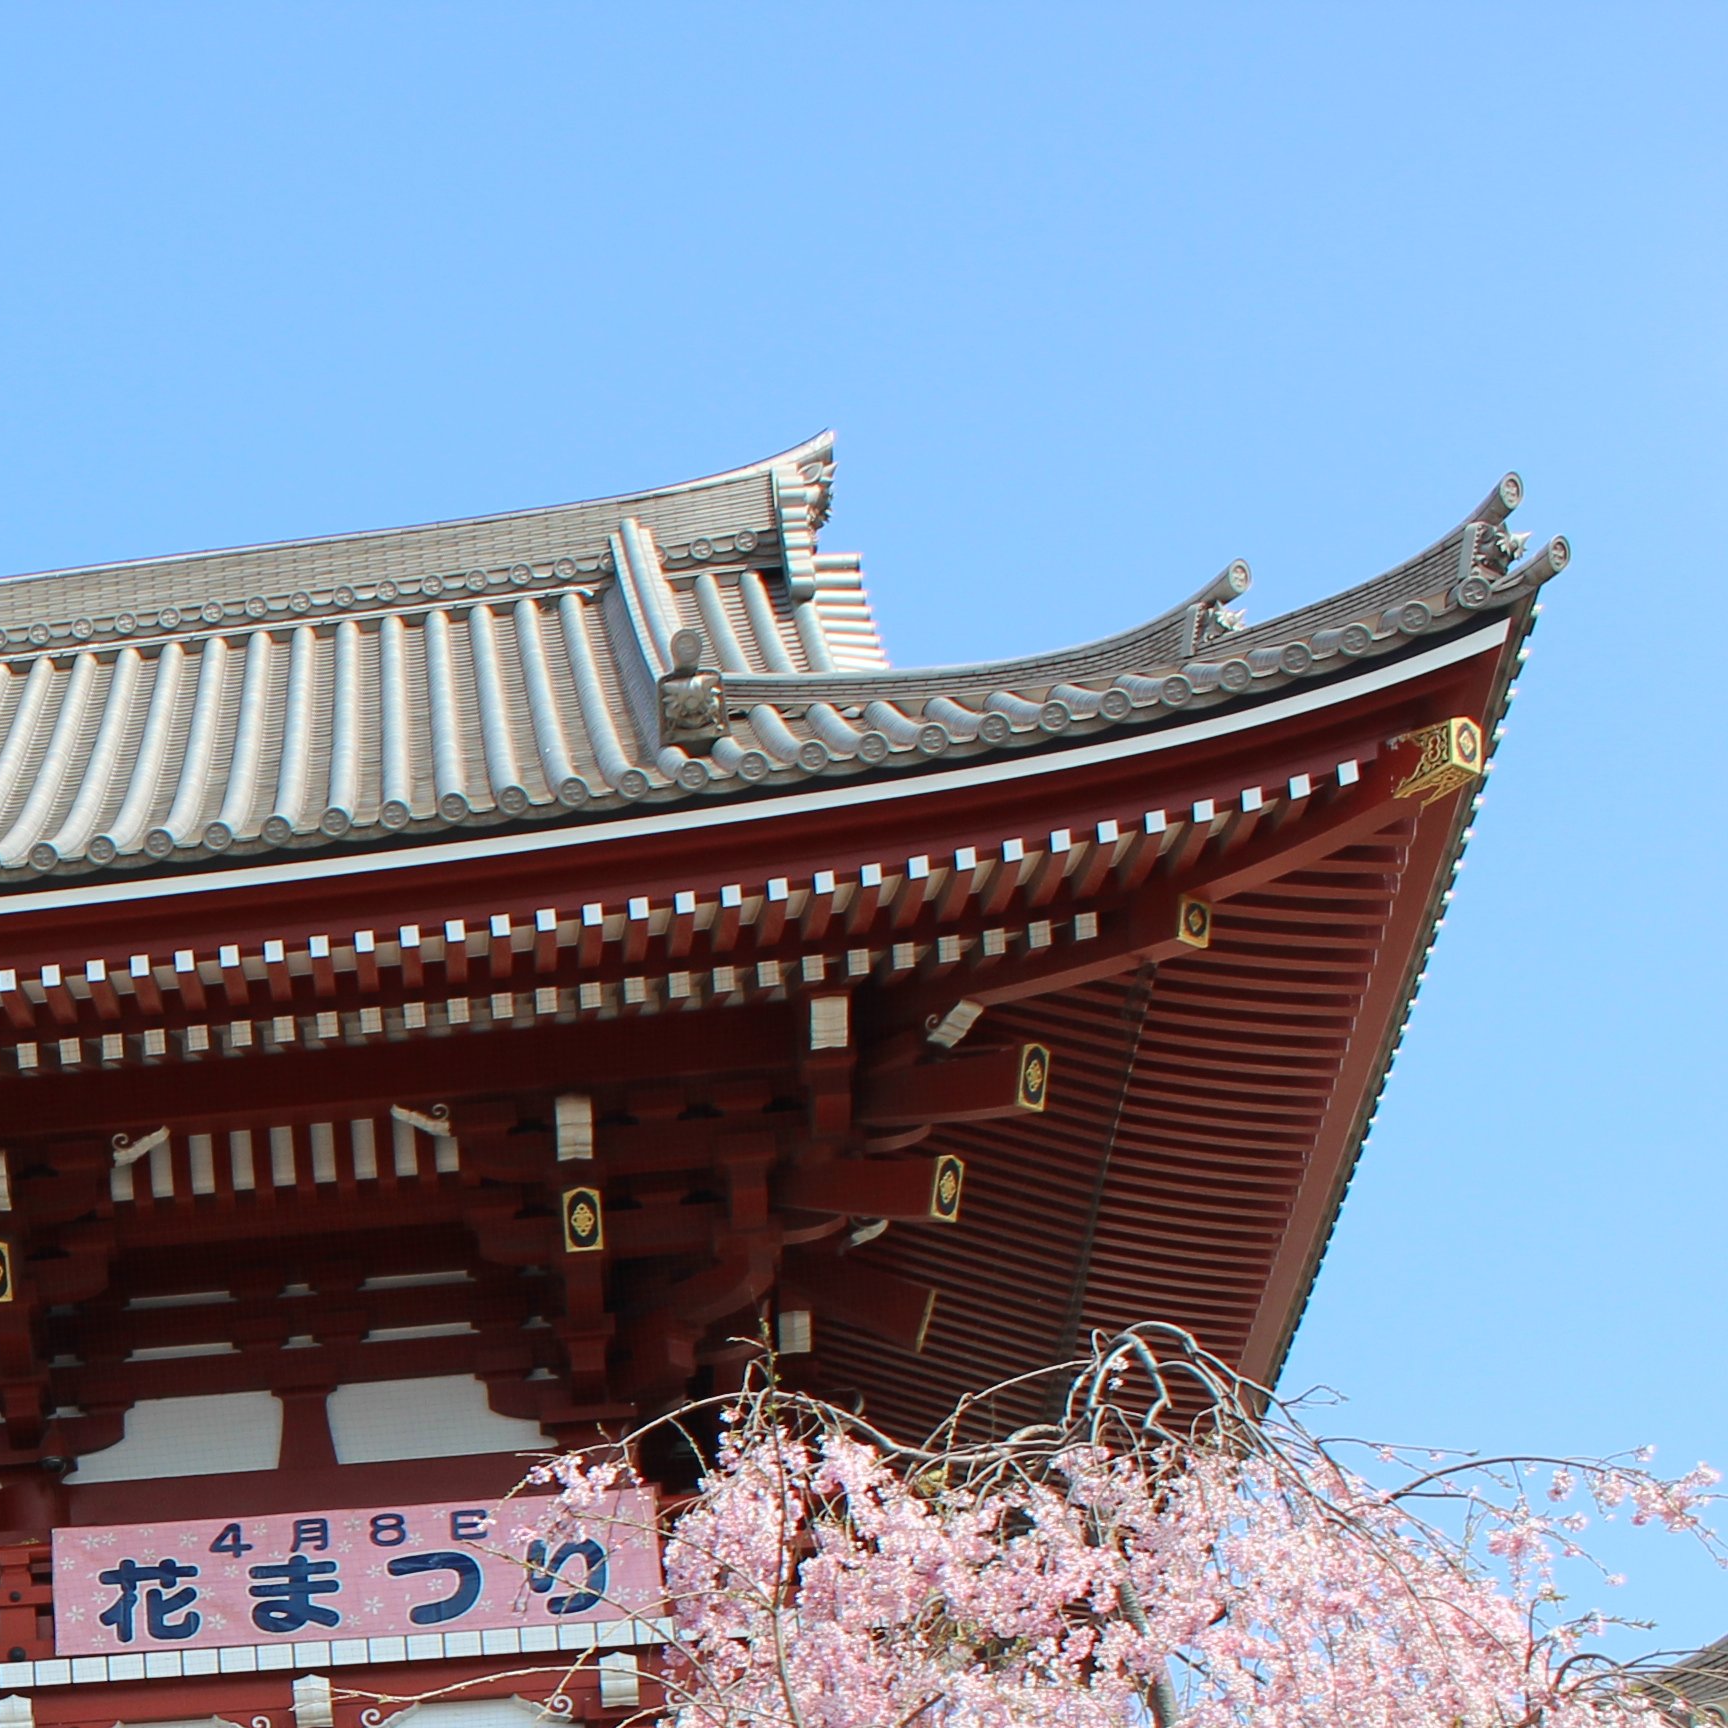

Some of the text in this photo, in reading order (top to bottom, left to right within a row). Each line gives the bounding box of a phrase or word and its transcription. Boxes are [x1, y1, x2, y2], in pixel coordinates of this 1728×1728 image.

[208, 1508, 490, 1558] 4月8日
[98, 1537, 608, 1643] 花まつり
